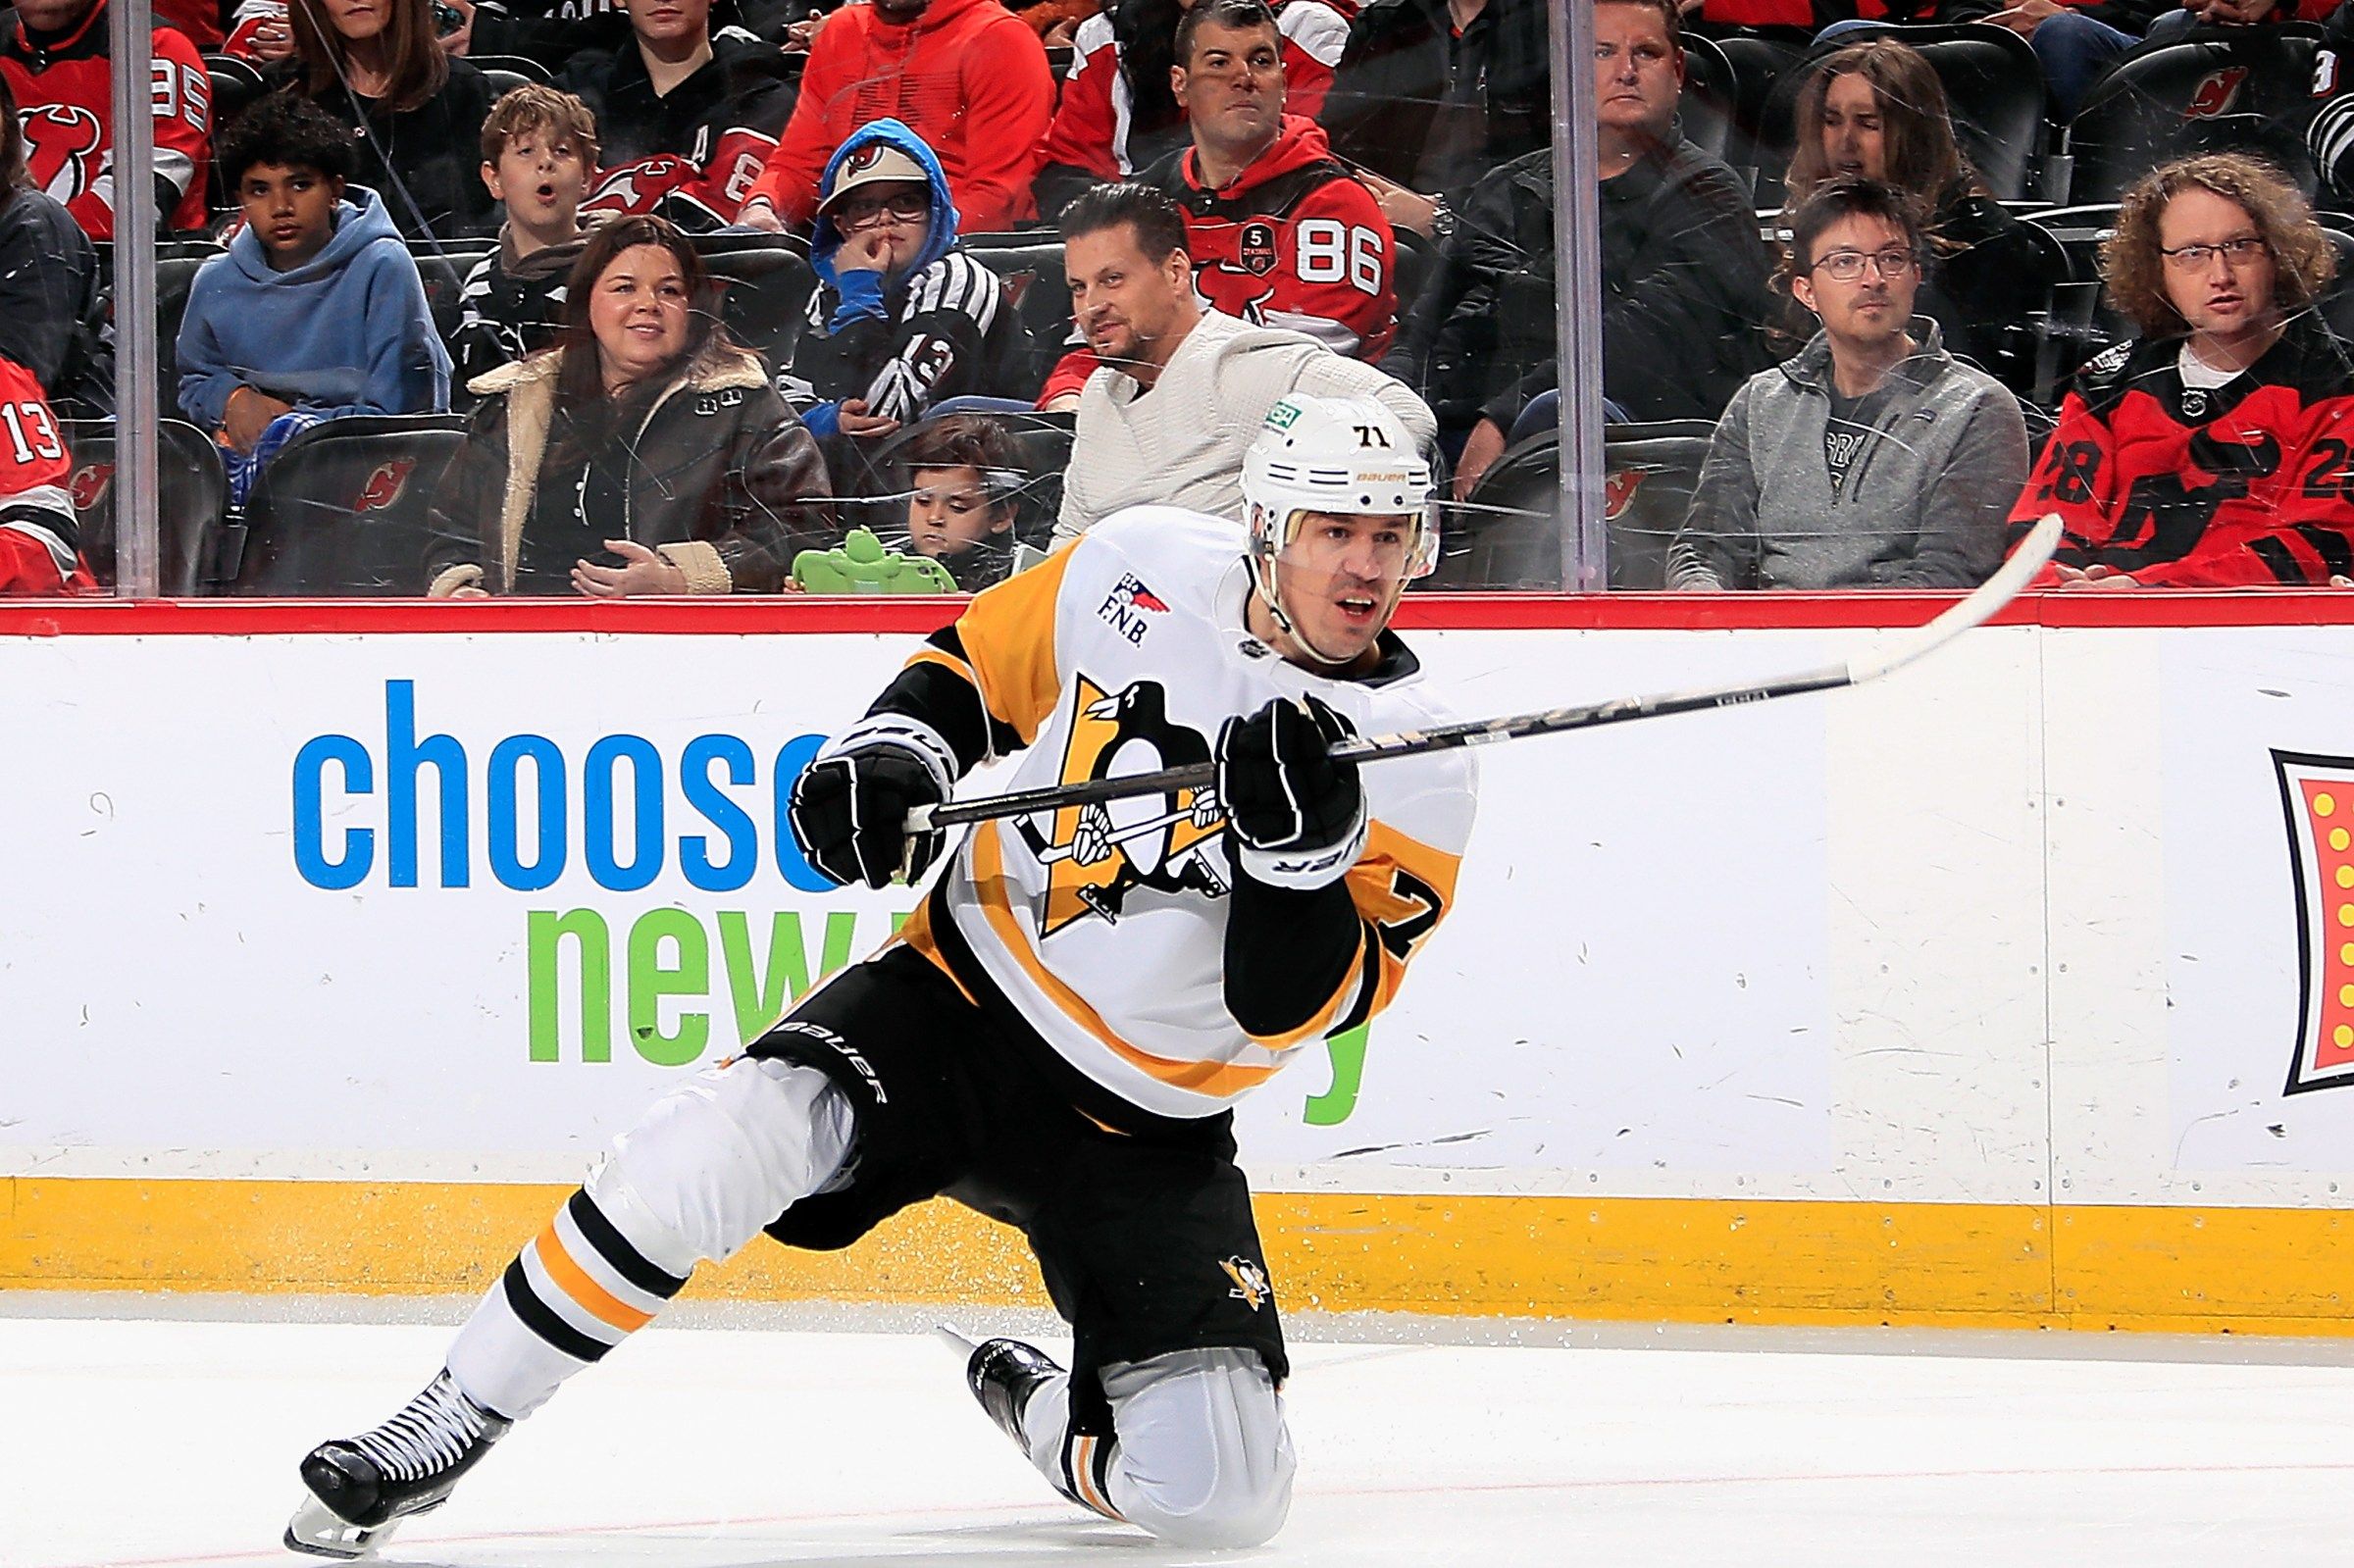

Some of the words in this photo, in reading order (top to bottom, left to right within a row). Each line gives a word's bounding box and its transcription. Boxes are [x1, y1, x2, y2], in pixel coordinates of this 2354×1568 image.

[1297, 219, 1383, 296] 86
[1, 402, 63, 464] 13
[1353, 426, 1391, 449] 71
[2303, 438, 2354, 505] 2
